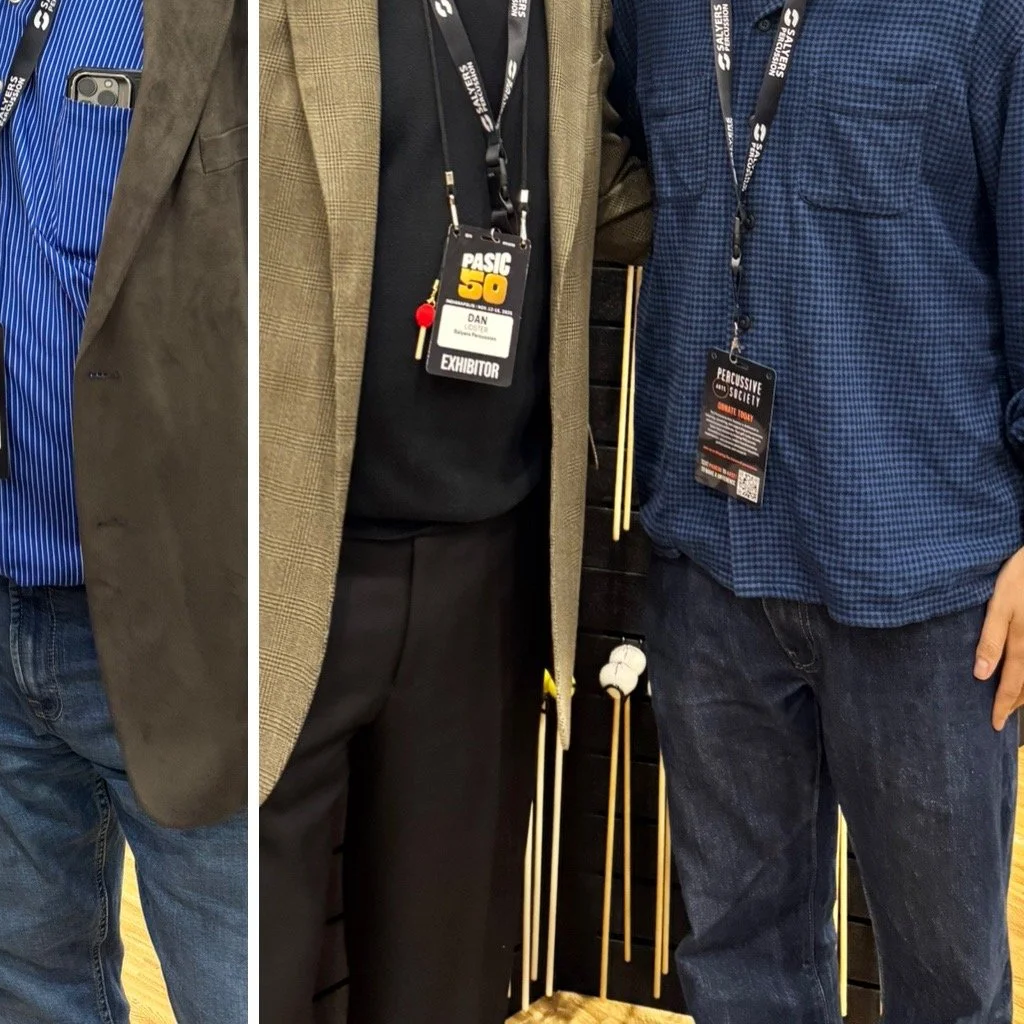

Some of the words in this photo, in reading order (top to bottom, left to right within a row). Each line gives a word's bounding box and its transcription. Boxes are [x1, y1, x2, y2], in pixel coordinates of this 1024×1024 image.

[713, 4, 725, 52] SALYERS
[721, 3, 730, 52] PERCUSSION
[768, 27, 786, 77] PERCUSSION
[776, 28, 796, 79] SALYERS
[458, 64, 484, 114] SALYERS
[461, 252, 512, 277] PASIC
[458, 267, 508, 306] 50
[467, 313, 488, 325] DAN
[440, 353, 500, 380] EXHIBITOR
[717, 366, 763, 396] PERCUSSIVE
[729, 386, 761, 408] SOCIETY
